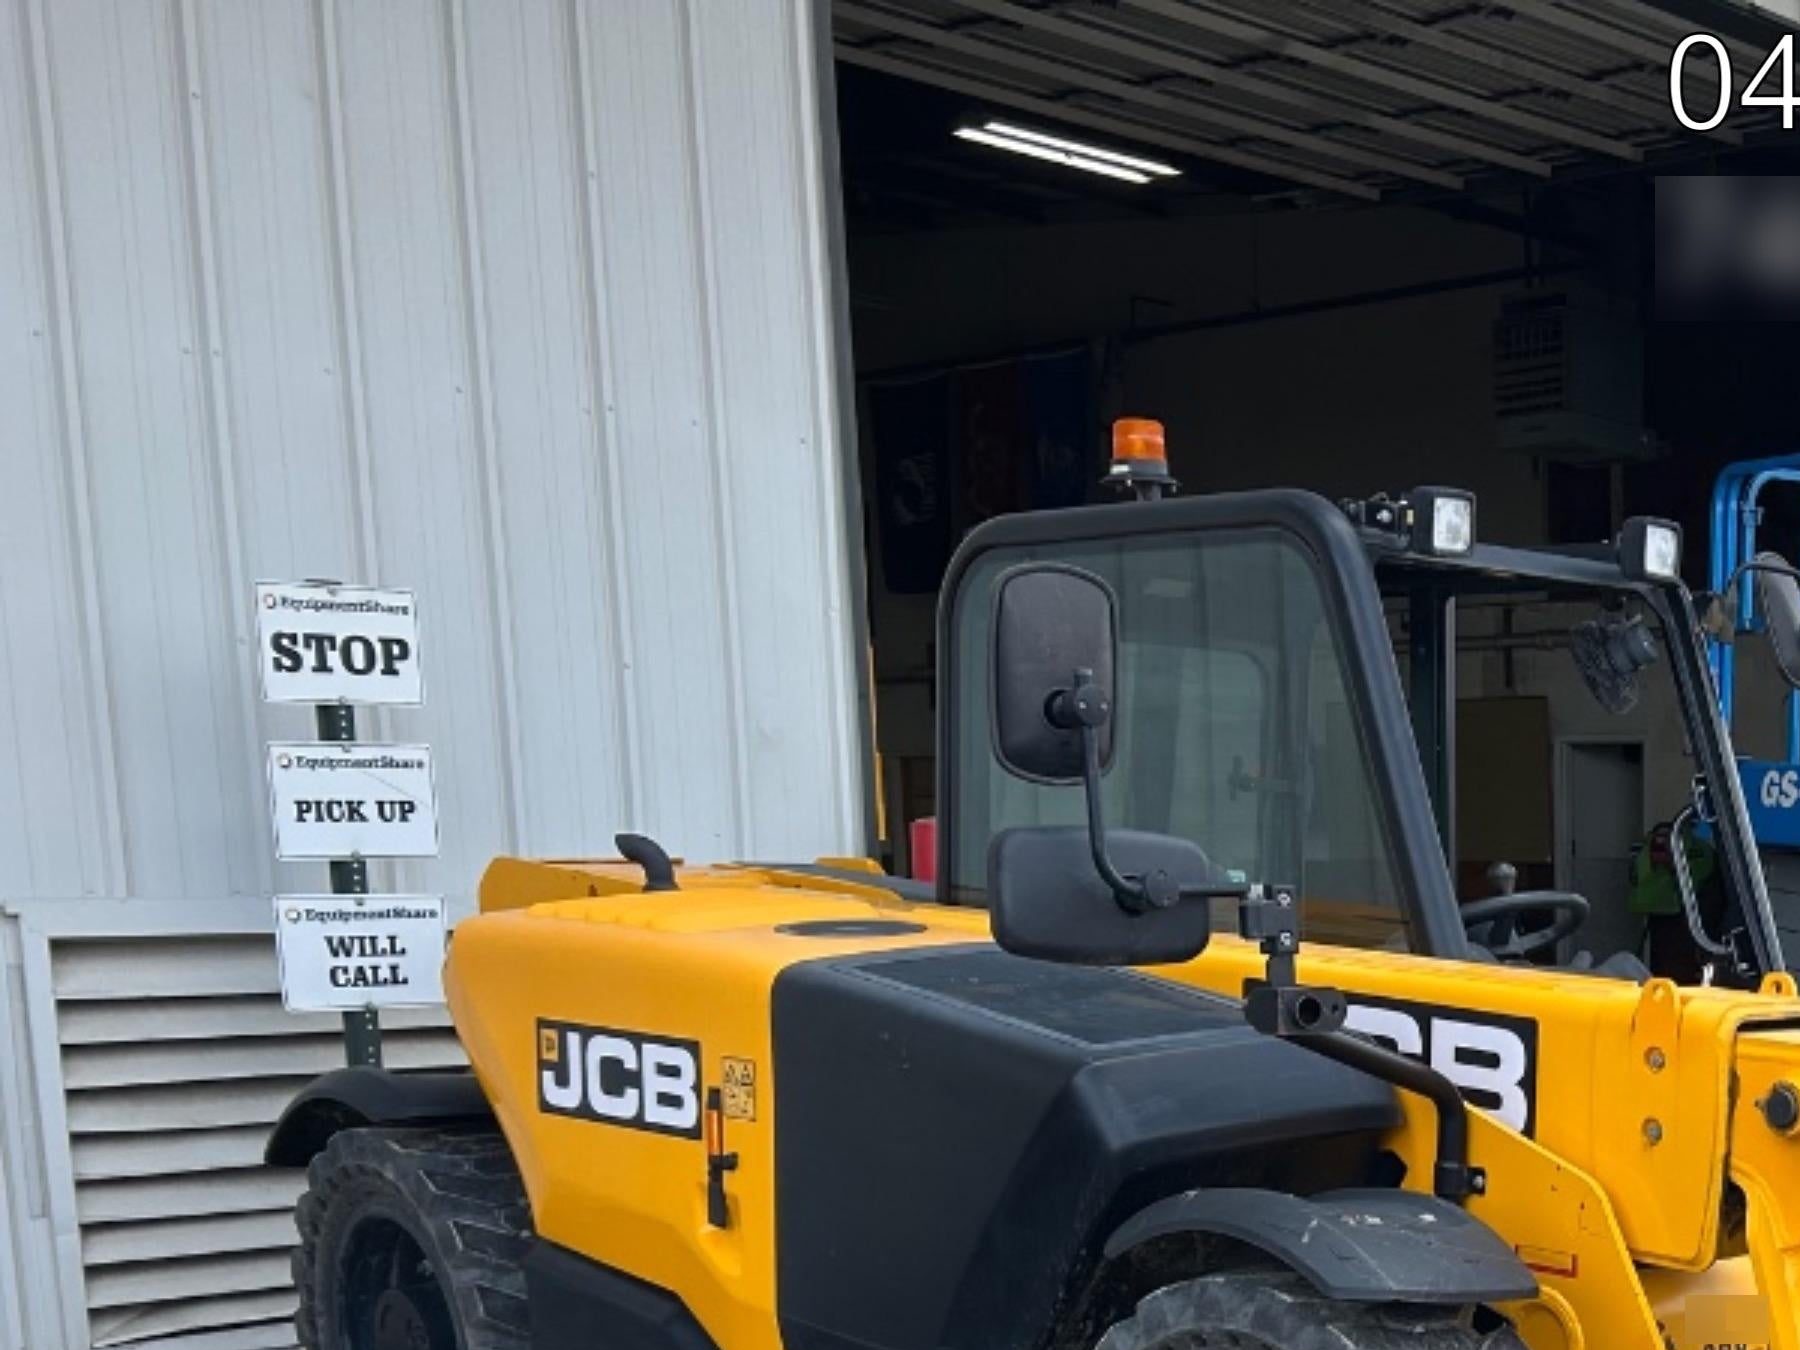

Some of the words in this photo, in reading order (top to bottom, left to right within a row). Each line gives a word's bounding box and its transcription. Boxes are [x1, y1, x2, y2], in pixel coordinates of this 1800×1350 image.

[271, 631, 410, 676] STOP
[294, 799, 368, 823] PICK
[376, 800, 416, 823] UP
[324, 935, 407, 958] WILL
[329, 963, 409, 989] CALL
[541, 1030, 700, 1130] JCB
